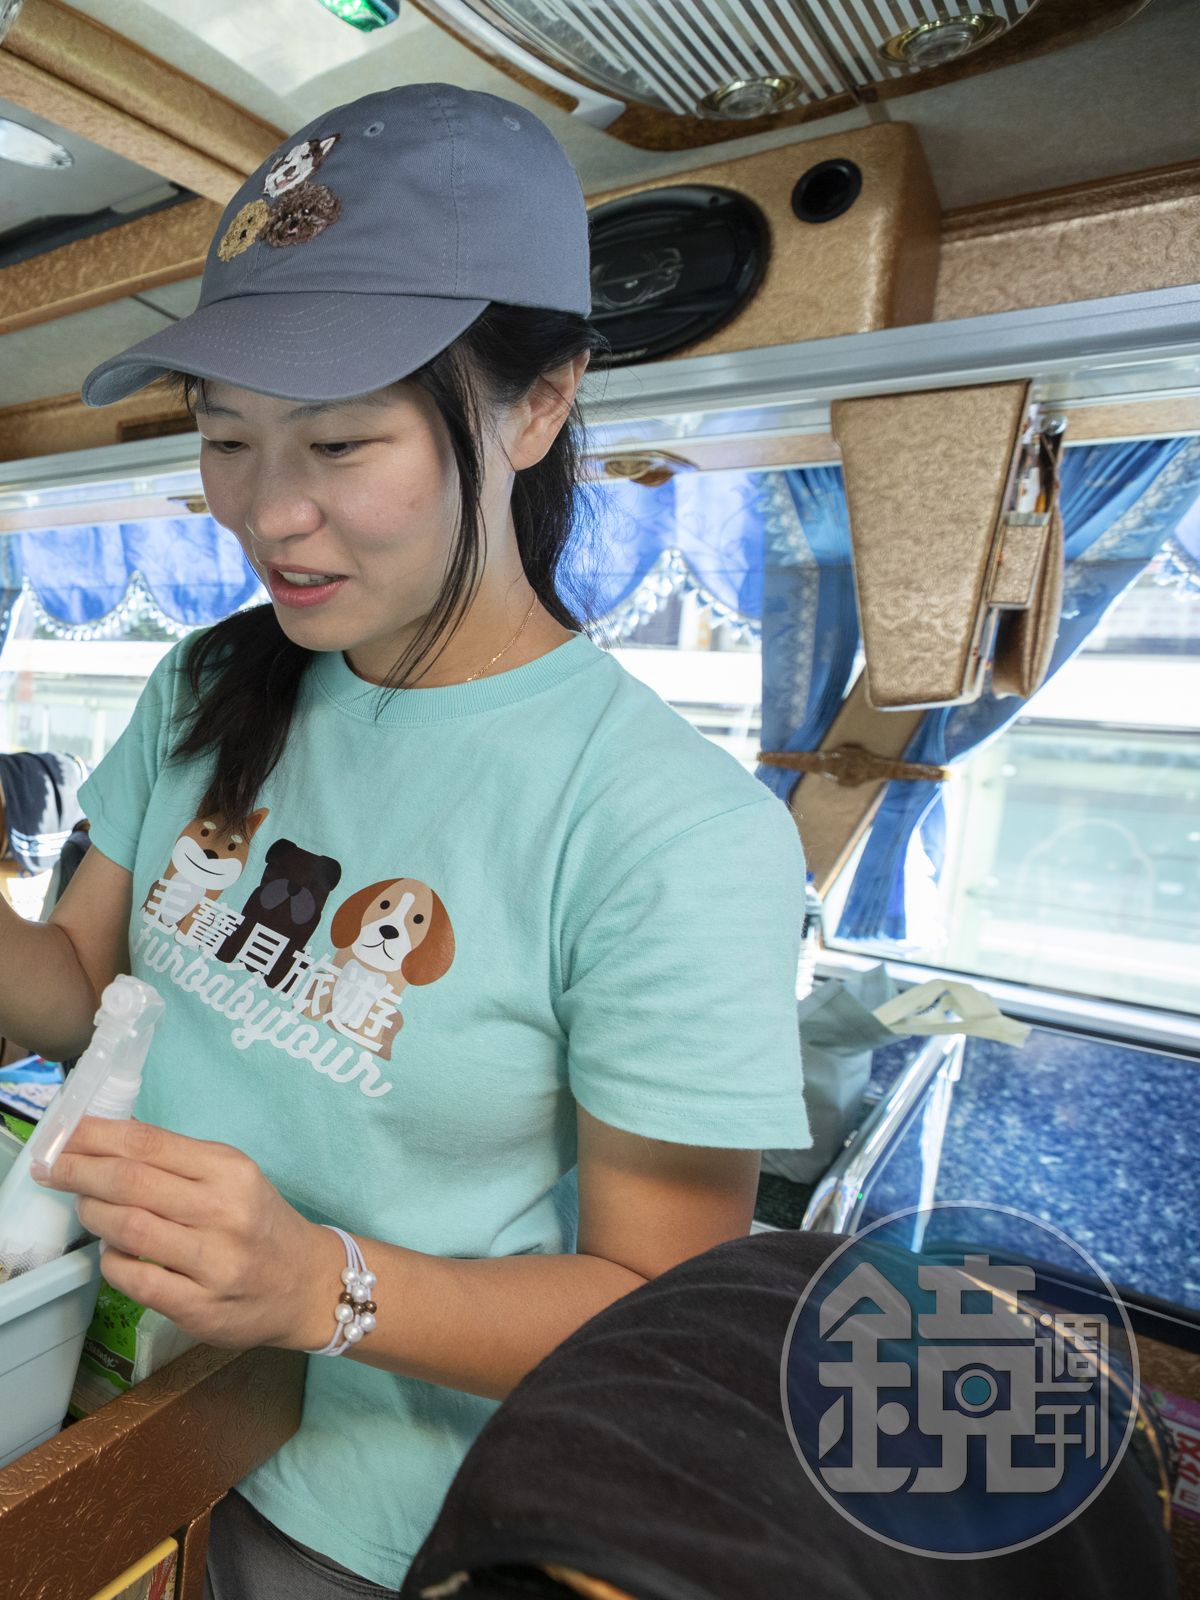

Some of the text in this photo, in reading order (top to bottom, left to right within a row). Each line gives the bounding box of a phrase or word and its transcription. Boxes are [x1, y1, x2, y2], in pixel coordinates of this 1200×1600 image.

[143, 878, 402, 1050] 毛寶貝旅遊
